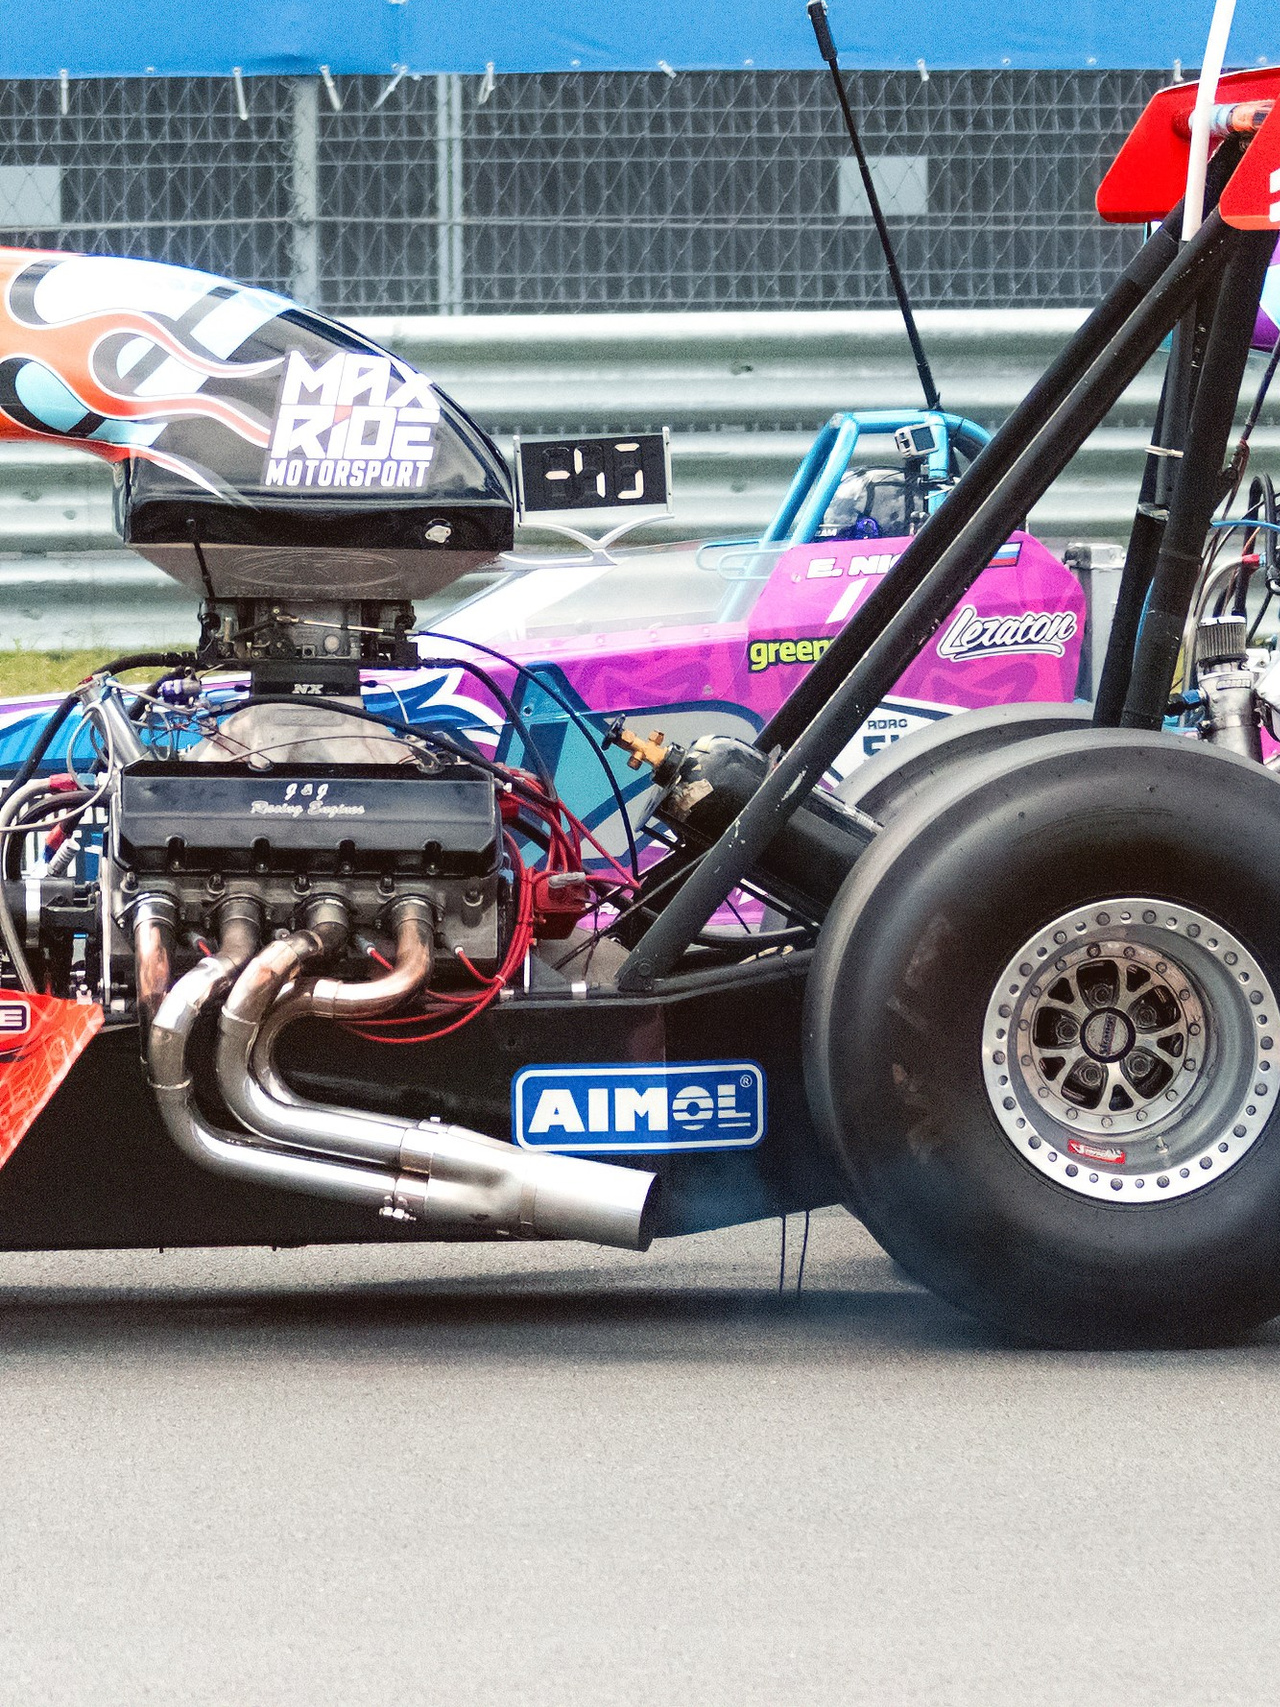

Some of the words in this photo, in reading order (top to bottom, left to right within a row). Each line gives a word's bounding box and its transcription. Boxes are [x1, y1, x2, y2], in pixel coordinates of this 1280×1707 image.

[280, 349, 441, 410] MAX
[264, 458, 430, 487] MOTORSPORT
[847, 552, 903, 576] NI
[293, 683, 324, 695] NX
[527, 1083, 752, 1134] AIMOL
